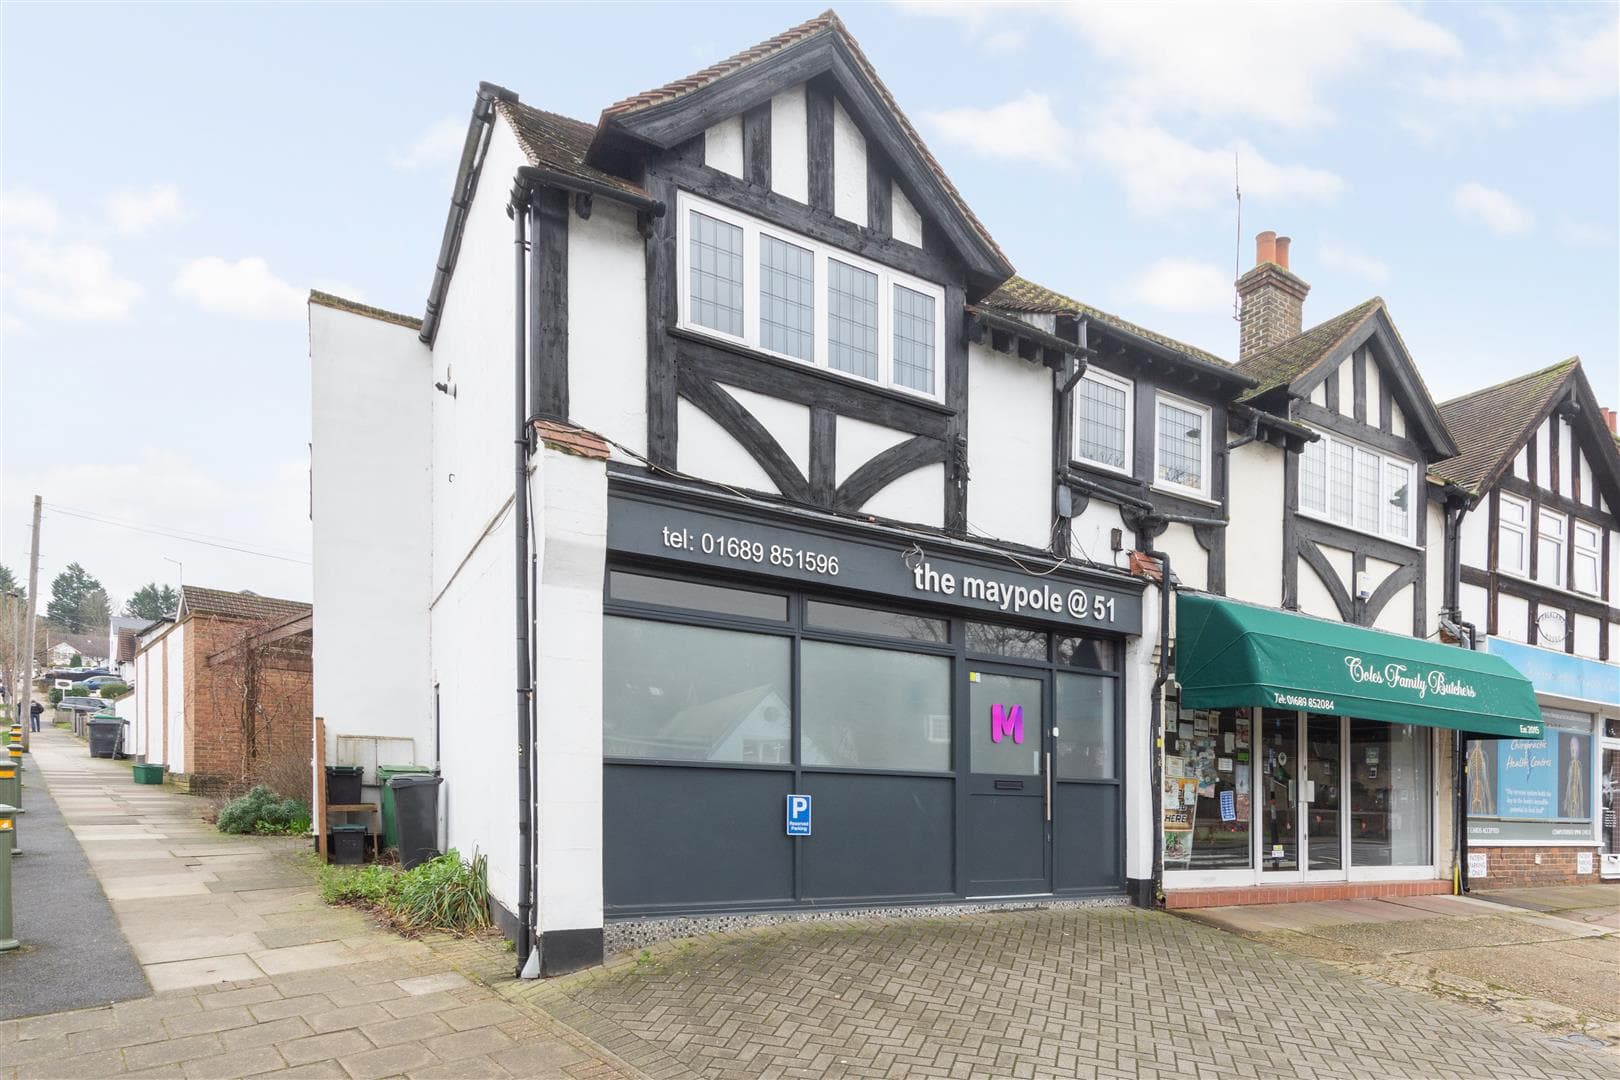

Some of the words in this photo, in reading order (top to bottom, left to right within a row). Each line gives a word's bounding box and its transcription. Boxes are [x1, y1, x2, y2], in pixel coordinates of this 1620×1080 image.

[662, 526, 694, 551] tel:
[701, 532, 764, 563] 01689
[769, 544, 839, 575] 851596
[914, 562, 955, 594] the
[963, 575, 1063, 612] maypole
[1068, 588, 1088, 618] @
[1093, 595, 1115, 622] 51
[1344, 656, 1384, 684] Coles
[1385, 663, 1426, 698] Family
[1428, 670, 1476, 698] Butchers
[1286, 695, 1307, 707] 01689
[1308, 698, 1334, 710] 852084
[991, 703, 1024, 744] M
[792, 798, 807, 818] P
[1165, 814, 1186, 822] HERE
